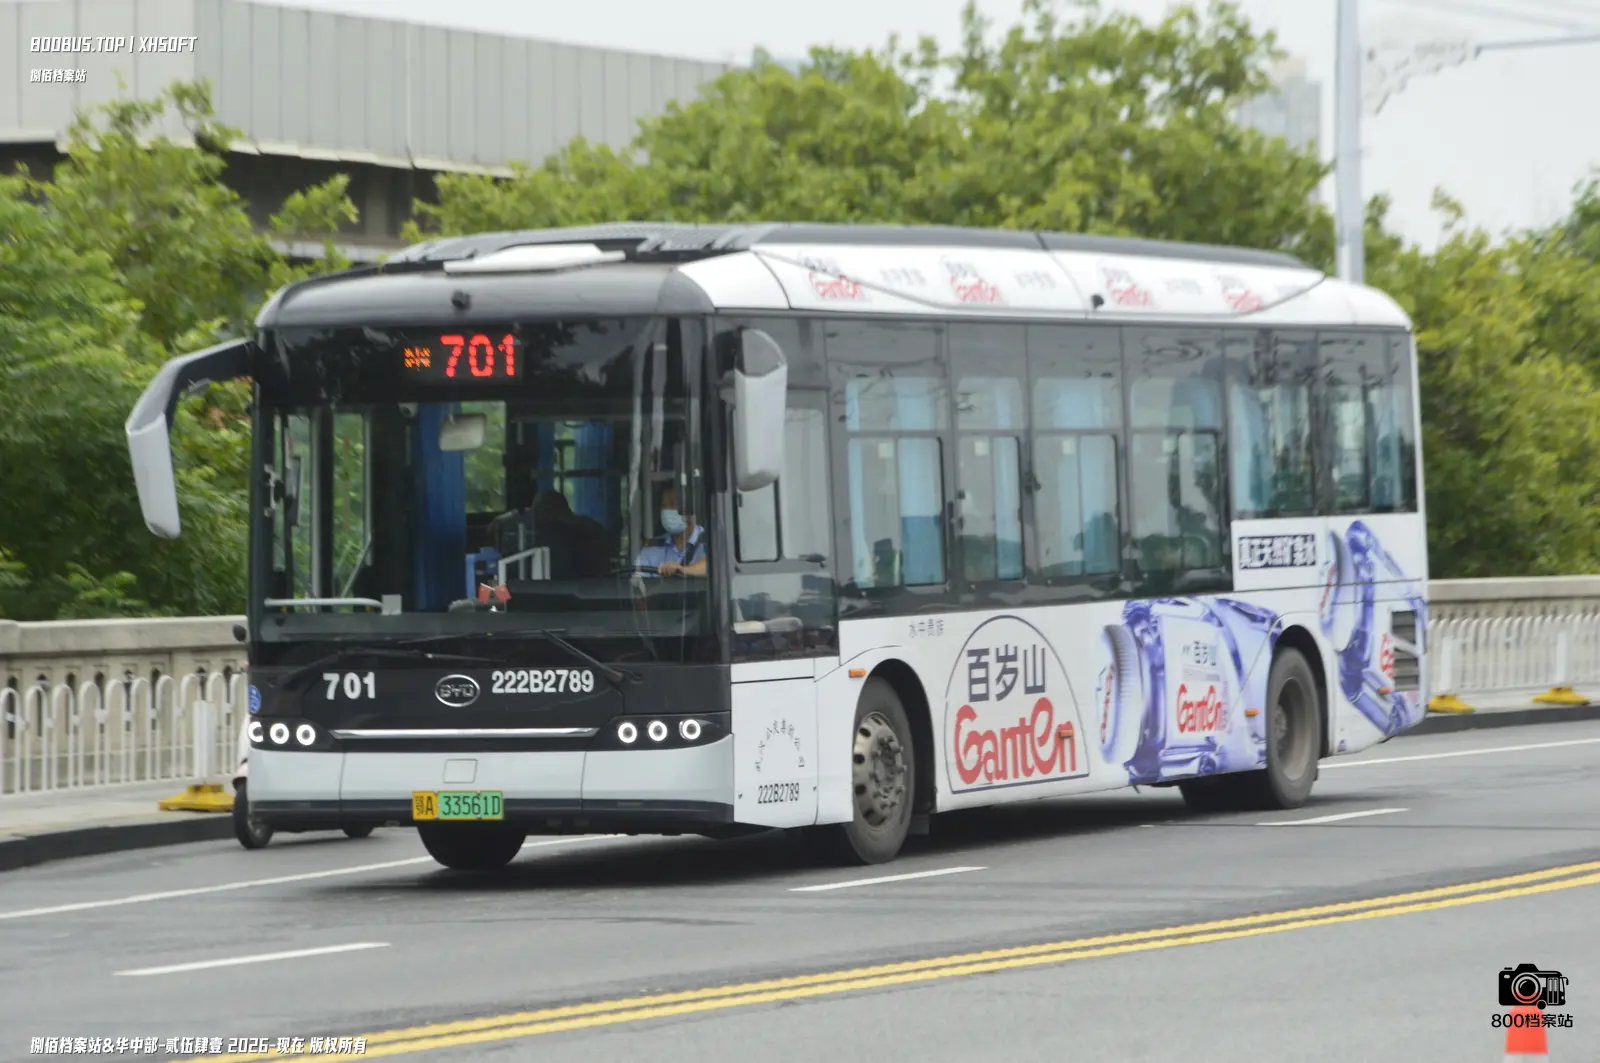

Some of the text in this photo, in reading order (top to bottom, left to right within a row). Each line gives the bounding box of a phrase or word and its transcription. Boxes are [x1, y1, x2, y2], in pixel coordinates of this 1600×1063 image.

[440, 333, 515, 378] 701
[322, 671, 376, 701] 701
[491, 669, 595, 694] 222B2789
[967, 644, 1046, 703] 百岁山
[954, 697, 1076, 785] Ganten
[757, 782, 800, 804] 222B2789
